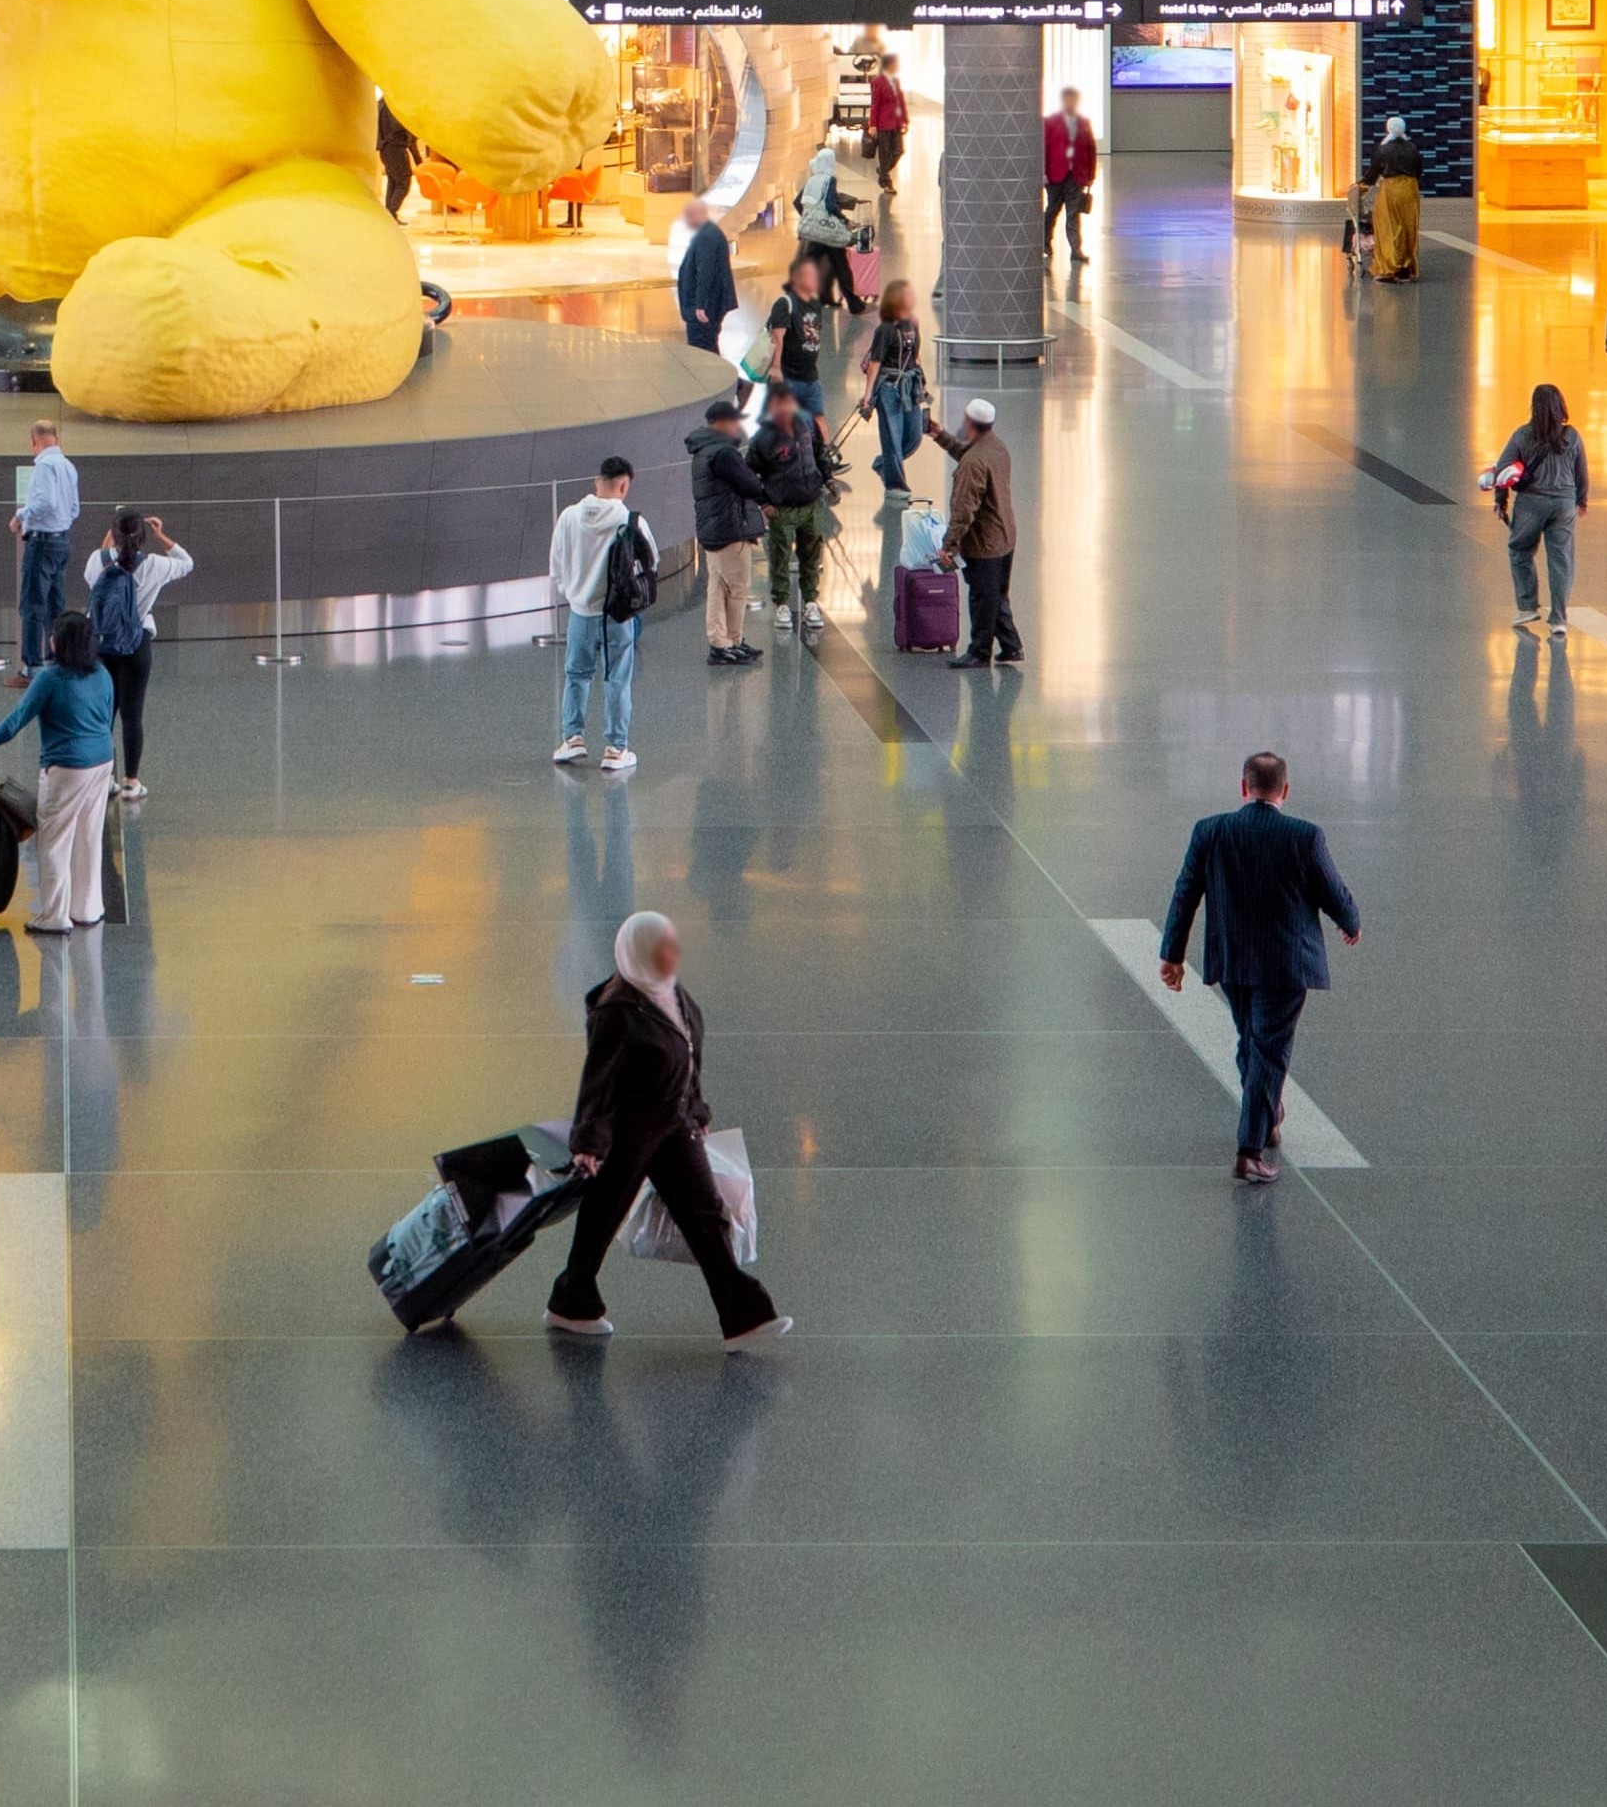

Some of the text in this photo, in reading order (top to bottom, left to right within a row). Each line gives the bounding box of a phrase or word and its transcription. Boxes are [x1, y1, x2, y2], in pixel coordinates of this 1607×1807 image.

[625, 4, 685, 17] Food Court
[692, 4, 763, 21] ركن المطاعم
[913, 3, 926, 17] Al
[963, 3, 1004, 20] Lounge
[1056, 3, 1084, 17] صالة
[1159, 2, 1218, 17] Hotel & Spa
[1225, 2, 1333, 17] الفندق والنادي الصحي
